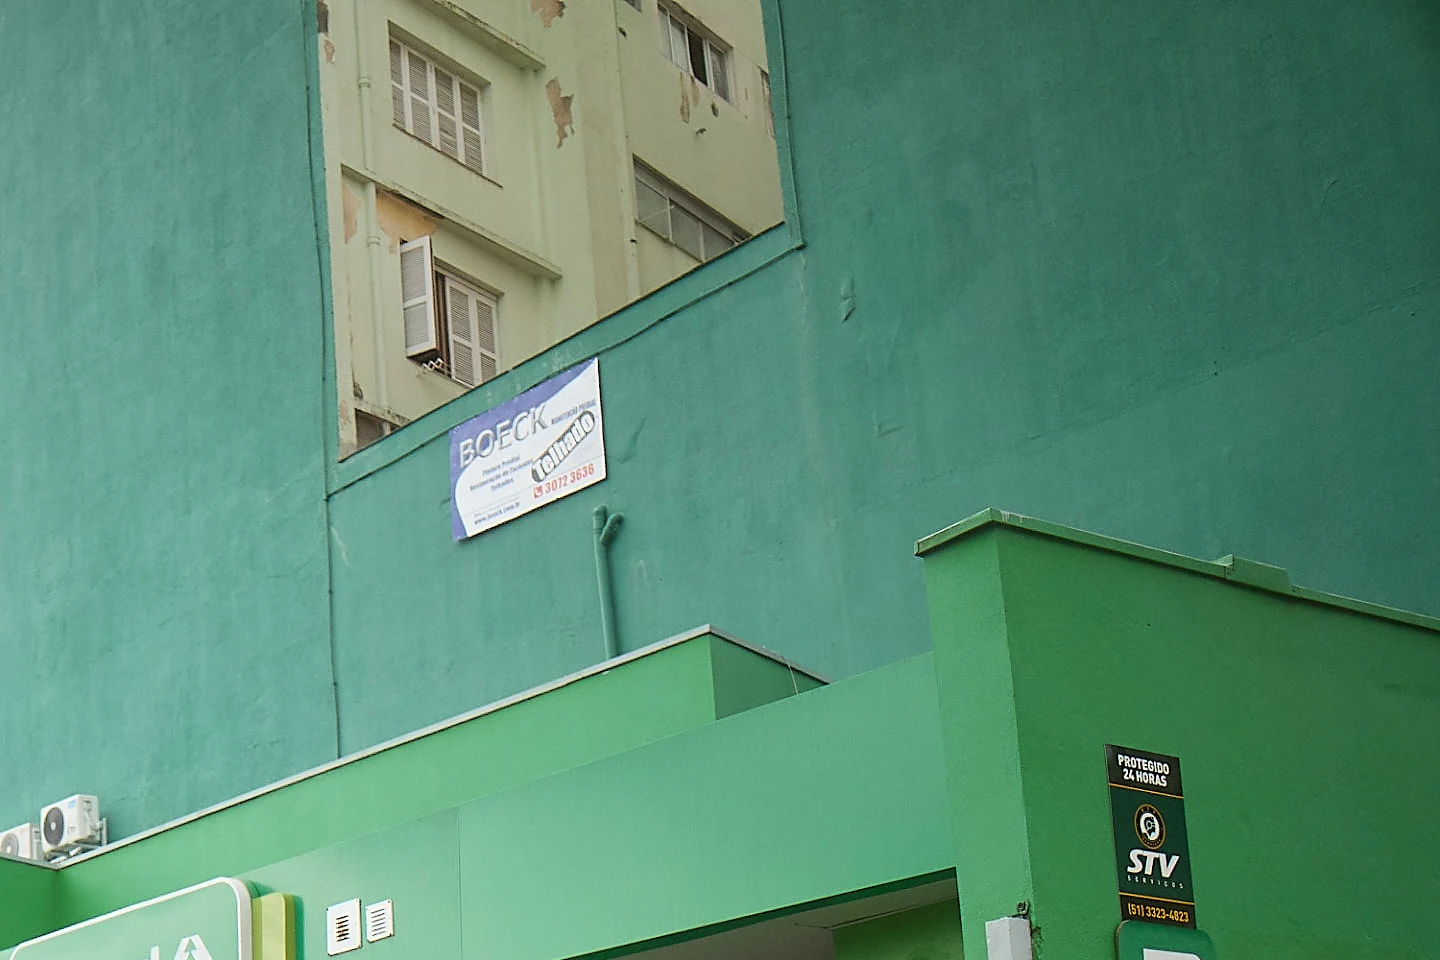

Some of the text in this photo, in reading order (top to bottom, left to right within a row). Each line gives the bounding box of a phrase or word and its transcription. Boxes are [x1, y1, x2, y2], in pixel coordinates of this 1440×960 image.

[459, 402, 548, 469] BOECK
[545, 475, 568, 494] 3072
[1117, 754, 1170, 775] PROTEGIDO
[1123, 768, 1168, 787] 24 HORAS
[1126, 849, 1180, 878] STV
[1127, 902, 1190, 923] (51) 3323-4823
